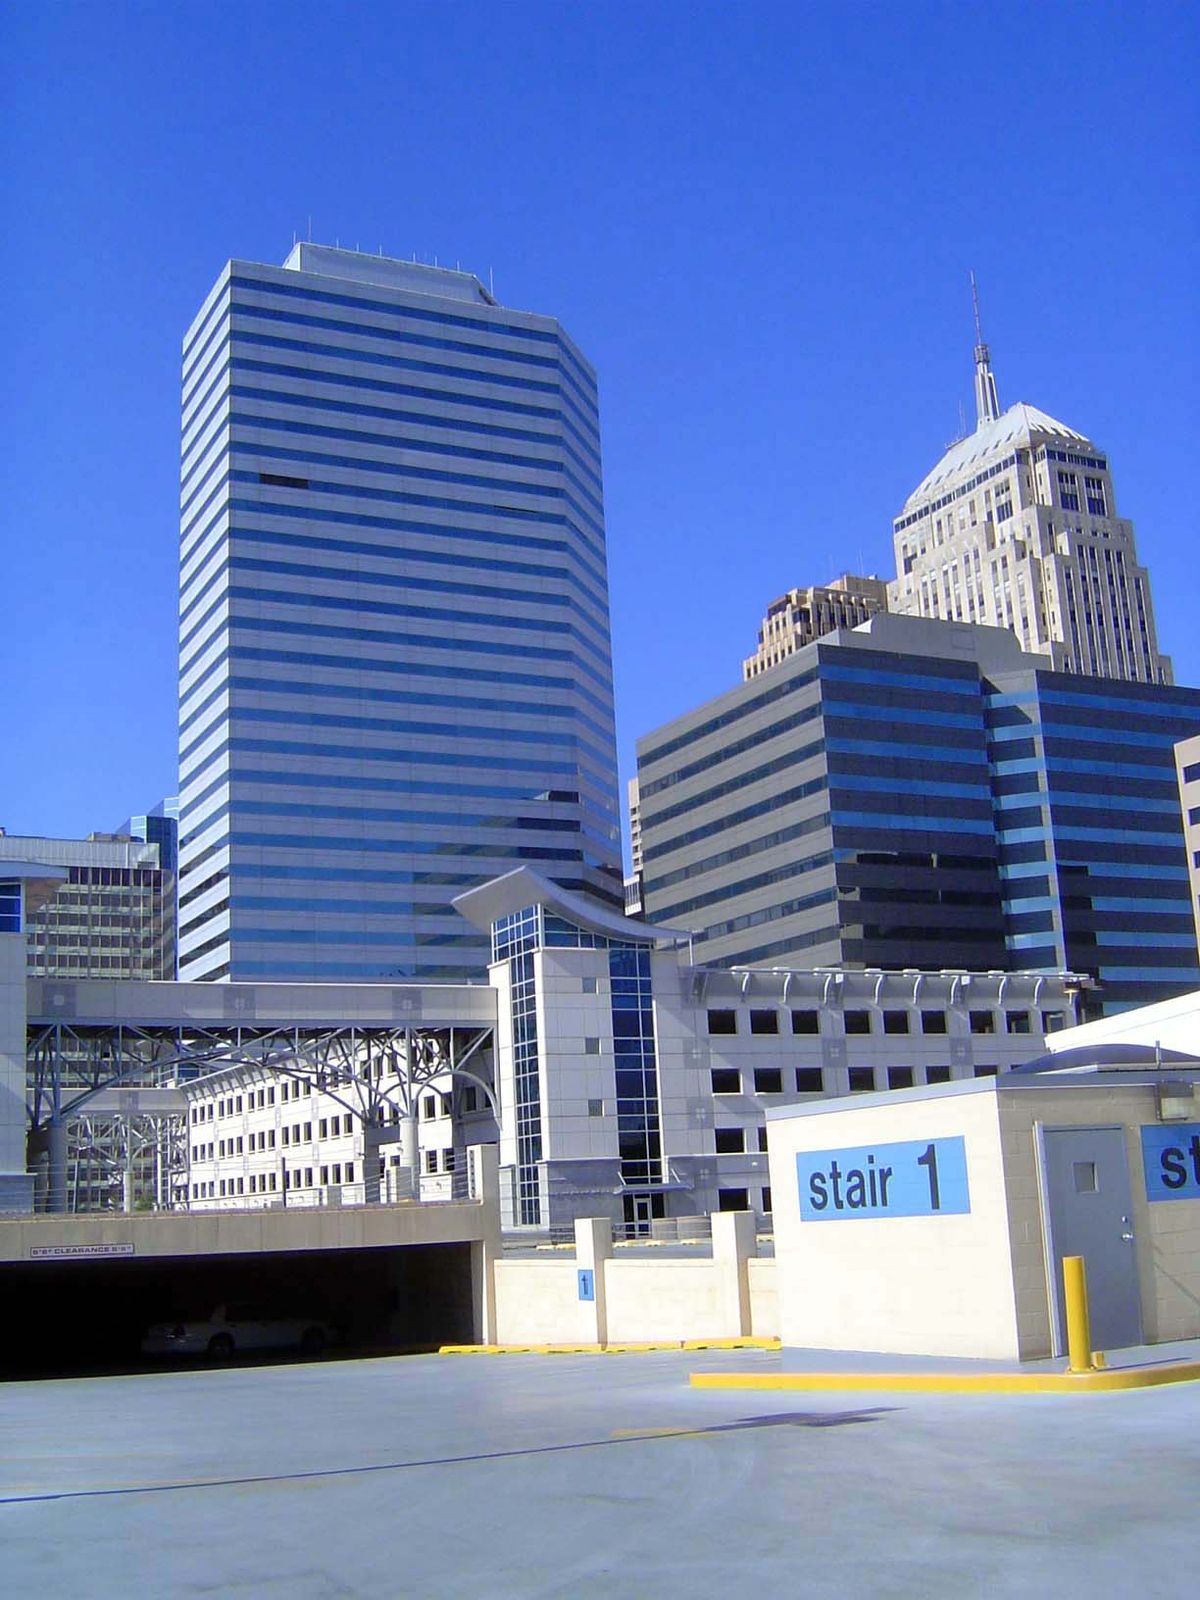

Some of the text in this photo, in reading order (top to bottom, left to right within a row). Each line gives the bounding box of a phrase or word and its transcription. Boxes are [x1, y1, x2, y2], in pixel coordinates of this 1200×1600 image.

[810, 1144, 940, 1210] stair 1
[54, 1246, 109, 1255] CLEARANCE
